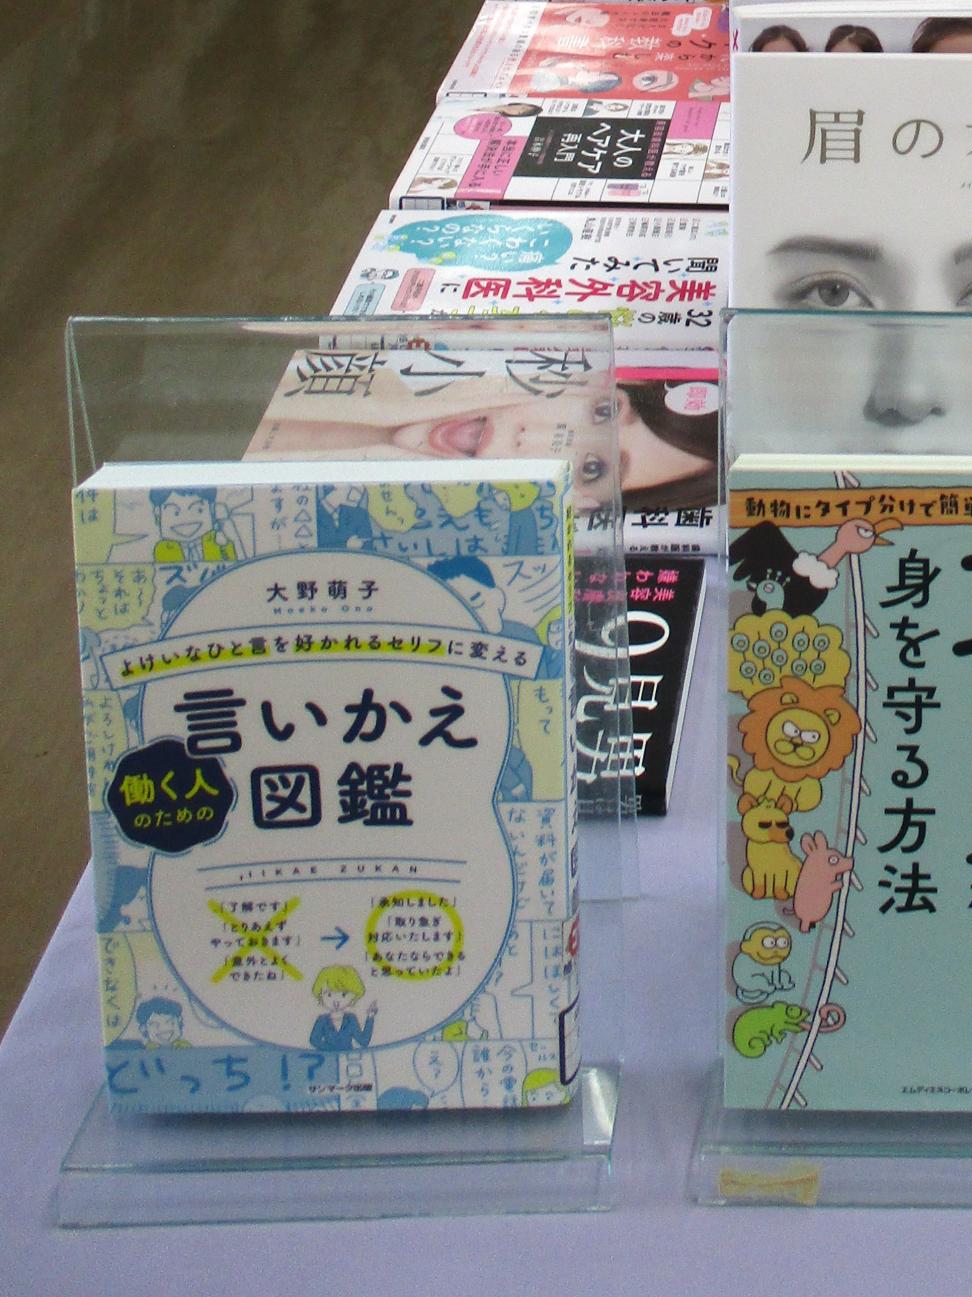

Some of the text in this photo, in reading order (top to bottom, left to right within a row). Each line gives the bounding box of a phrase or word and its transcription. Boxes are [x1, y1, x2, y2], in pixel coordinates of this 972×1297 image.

[554, 133, 581, 162] 再入門
[577, 122, 612, 174] ヘアケア
[611, 129, 646, 168] 大人の
[569, 257, 720, 273] 聞いてみた
[636, 309, 714, 328] 32歳の
[267, 581, 379, 601] 大野萌子
[121, 634, 528, 677] よけいなひと言を好かれるセリフに変える
[174, 685, 478, 756] 言いかえ
[877, 548, 942, 914] 身を守る方法
[119, 768, 219, 806] 働く人
[250, 762, 413, 828] 図鑑
[134, 807, 214, 828] のための
[341, 865, 418, 874] ZUKAN
